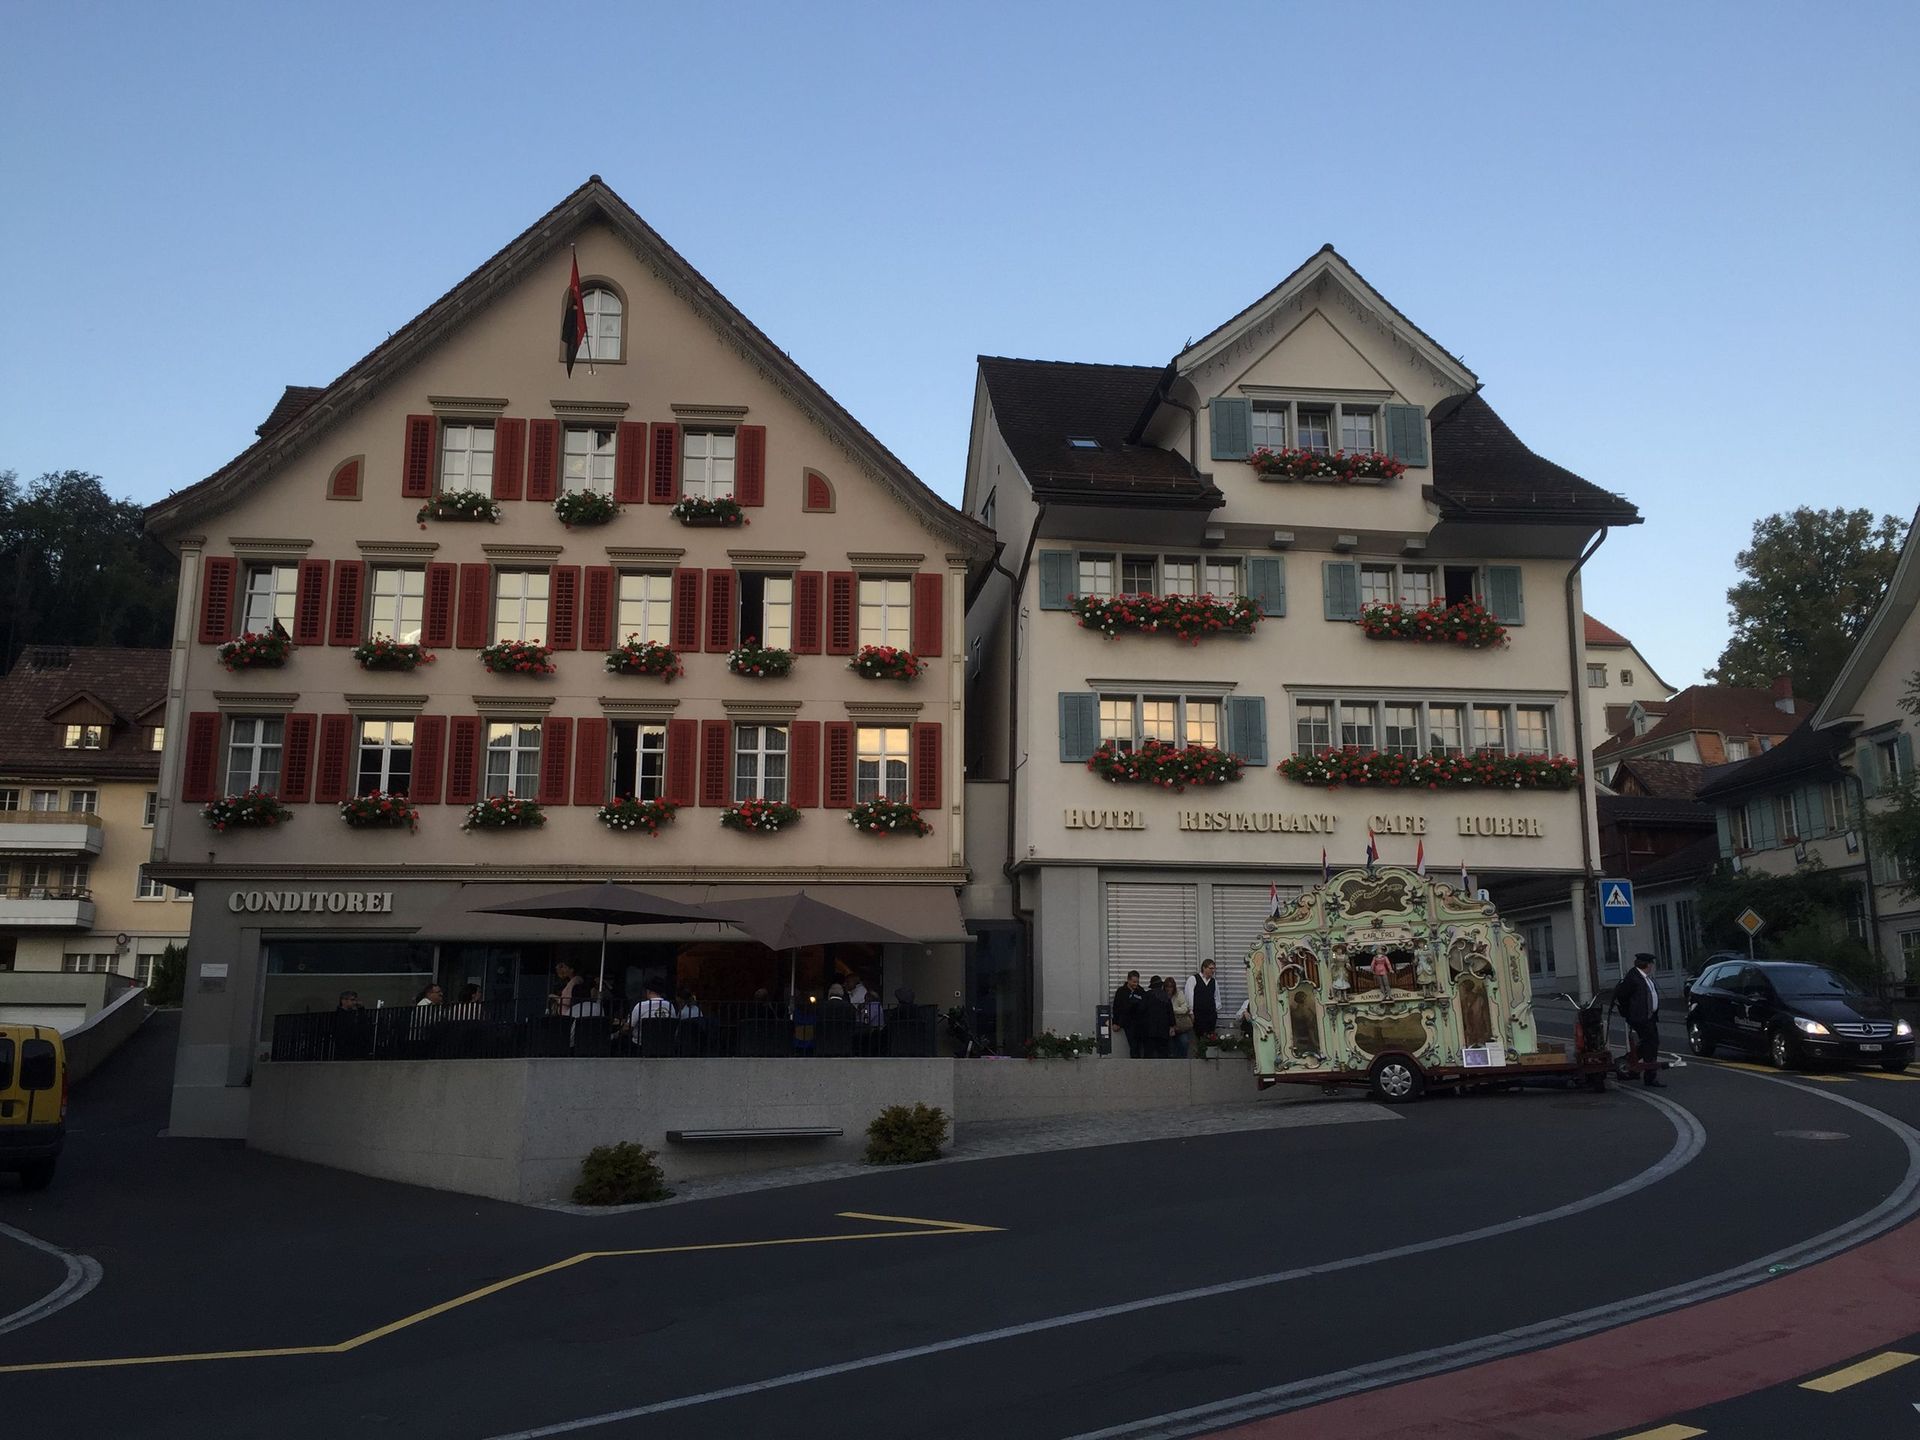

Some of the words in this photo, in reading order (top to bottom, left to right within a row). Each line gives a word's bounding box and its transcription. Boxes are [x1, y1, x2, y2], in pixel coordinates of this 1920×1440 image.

[1064, 809, 1146, 830] HOTEL
[1178, 811, 1338, 834] RESTAURANT
[1368, 814, 1427, 835] CAFE
[1457, 815, 1544, 837] HUBER
[228, 891, 393, 913] CONDITOREI
[1362, 932, 1379, 940] CARL
